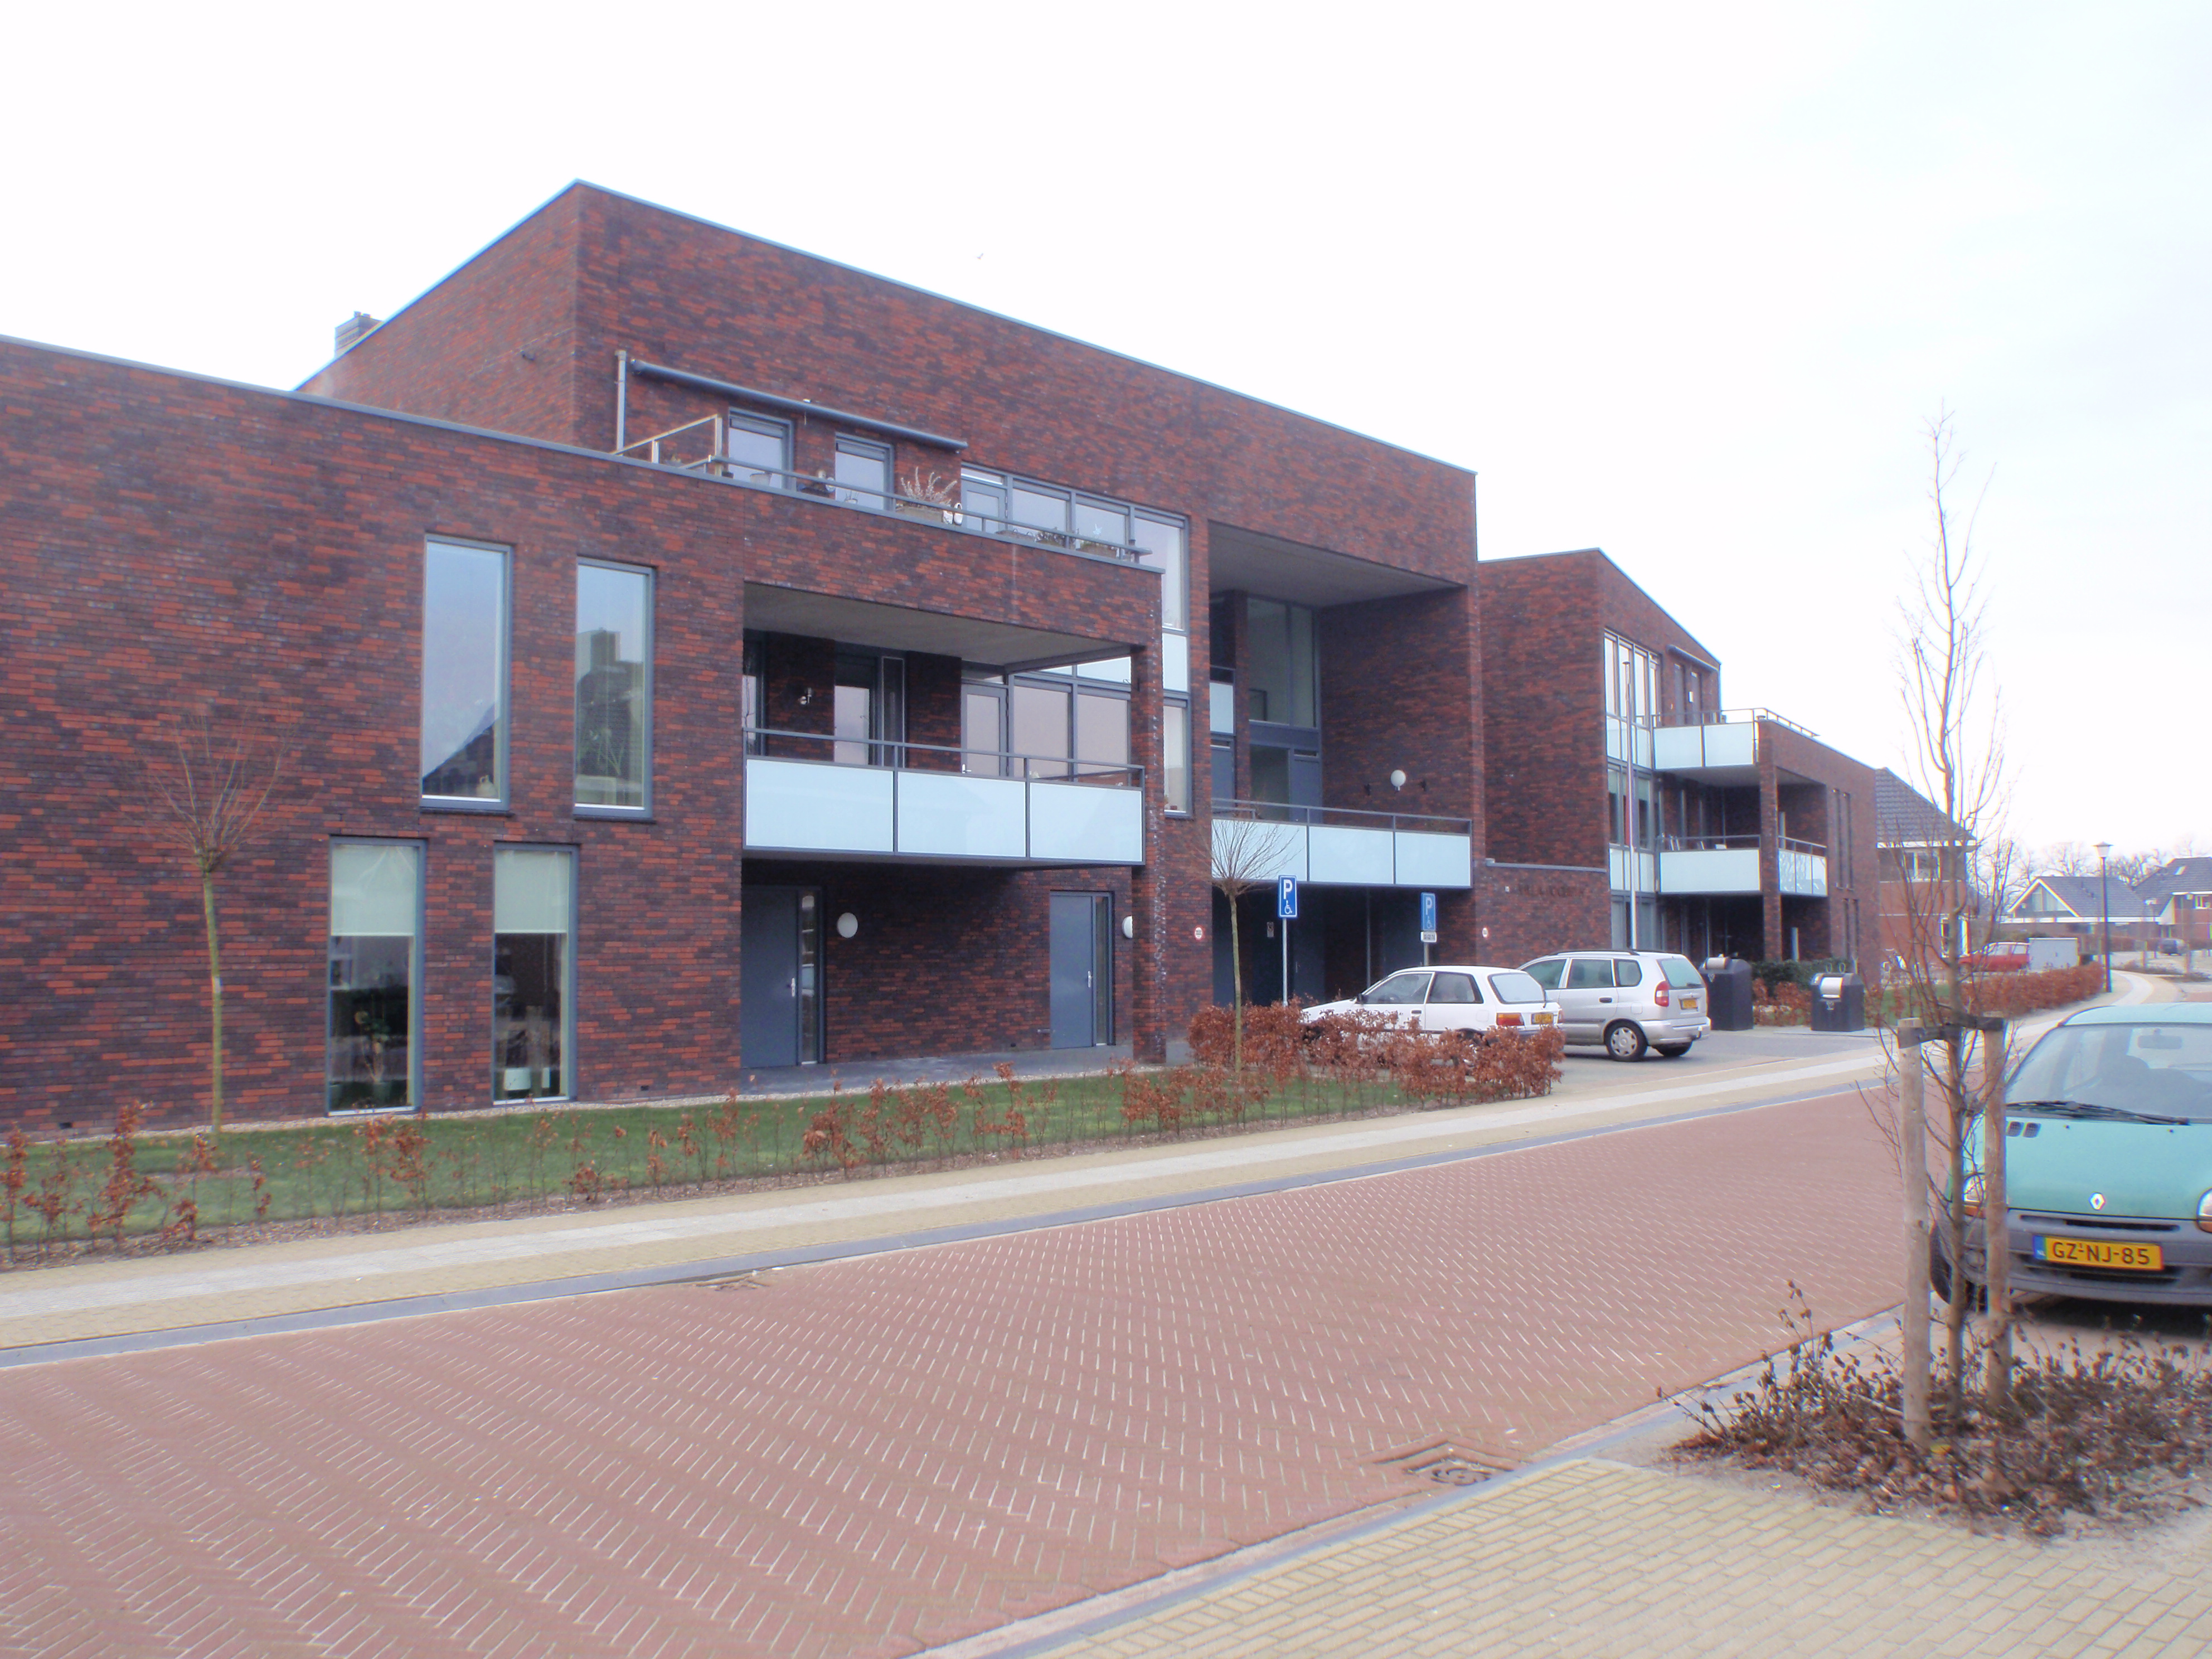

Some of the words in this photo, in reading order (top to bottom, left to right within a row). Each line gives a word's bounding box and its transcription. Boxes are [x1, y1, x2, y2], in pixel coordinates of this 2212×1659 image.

[1283, 879, 1293, 899] P
[1425, 896, 1433, 915] P
[2053, 1241, 2150, 1265] GZ-NJ-85
